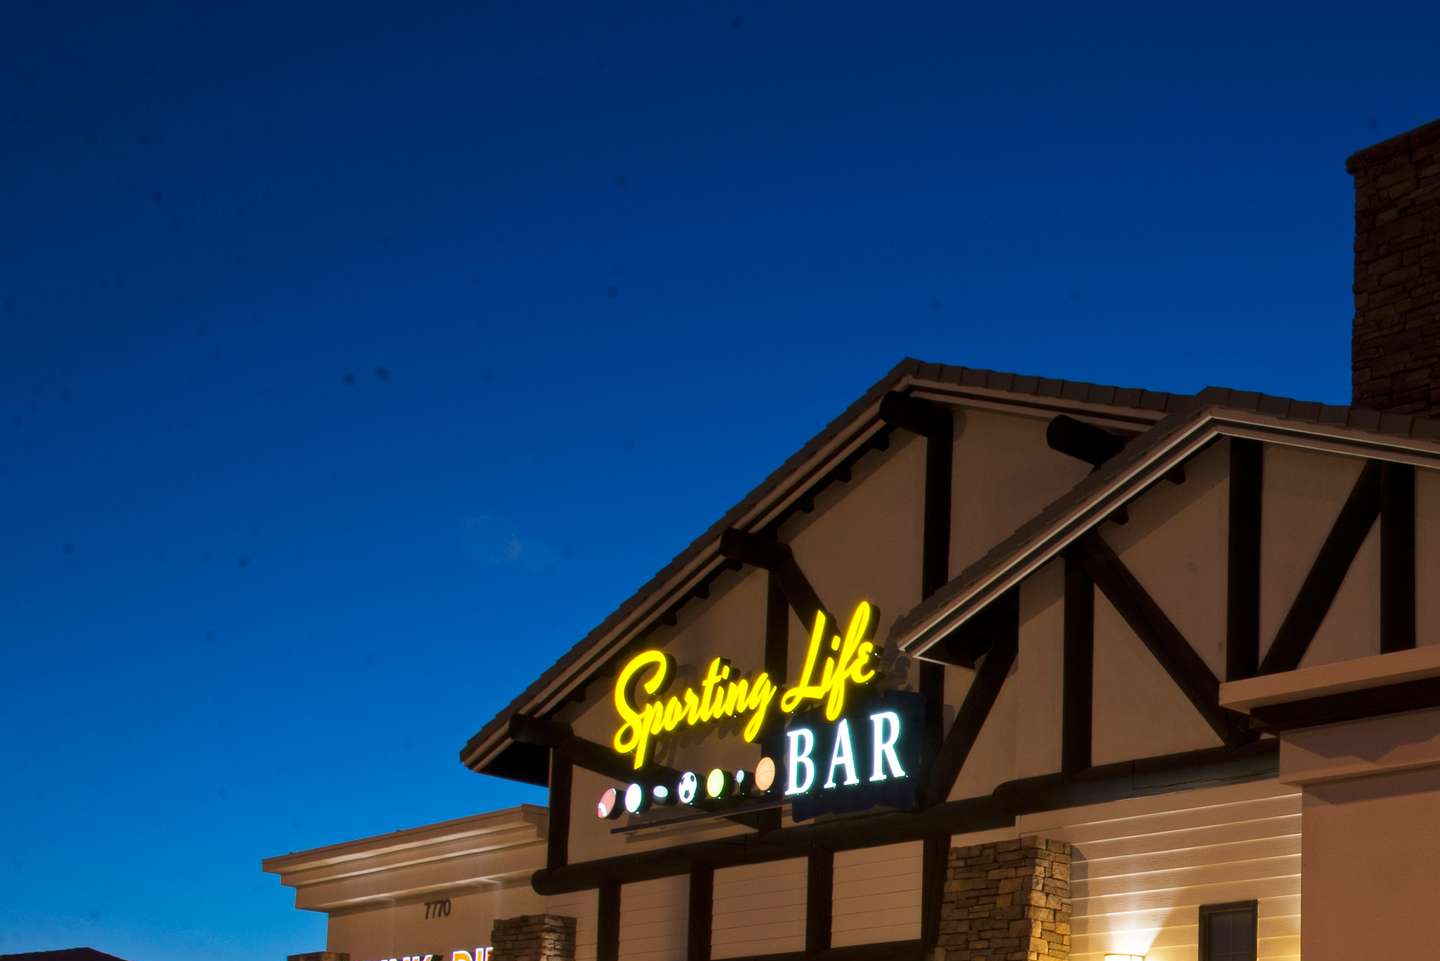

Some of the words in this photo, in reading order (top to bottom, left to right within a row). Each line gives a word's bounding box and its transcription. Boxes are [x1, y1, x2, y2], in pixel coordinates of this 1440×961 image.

[613, 650, 777, 770] Sporting
[781, 601, 875, 721] Life
[784, 710, 907, 796] BAR
[424, 899, 452, 920] 7770
